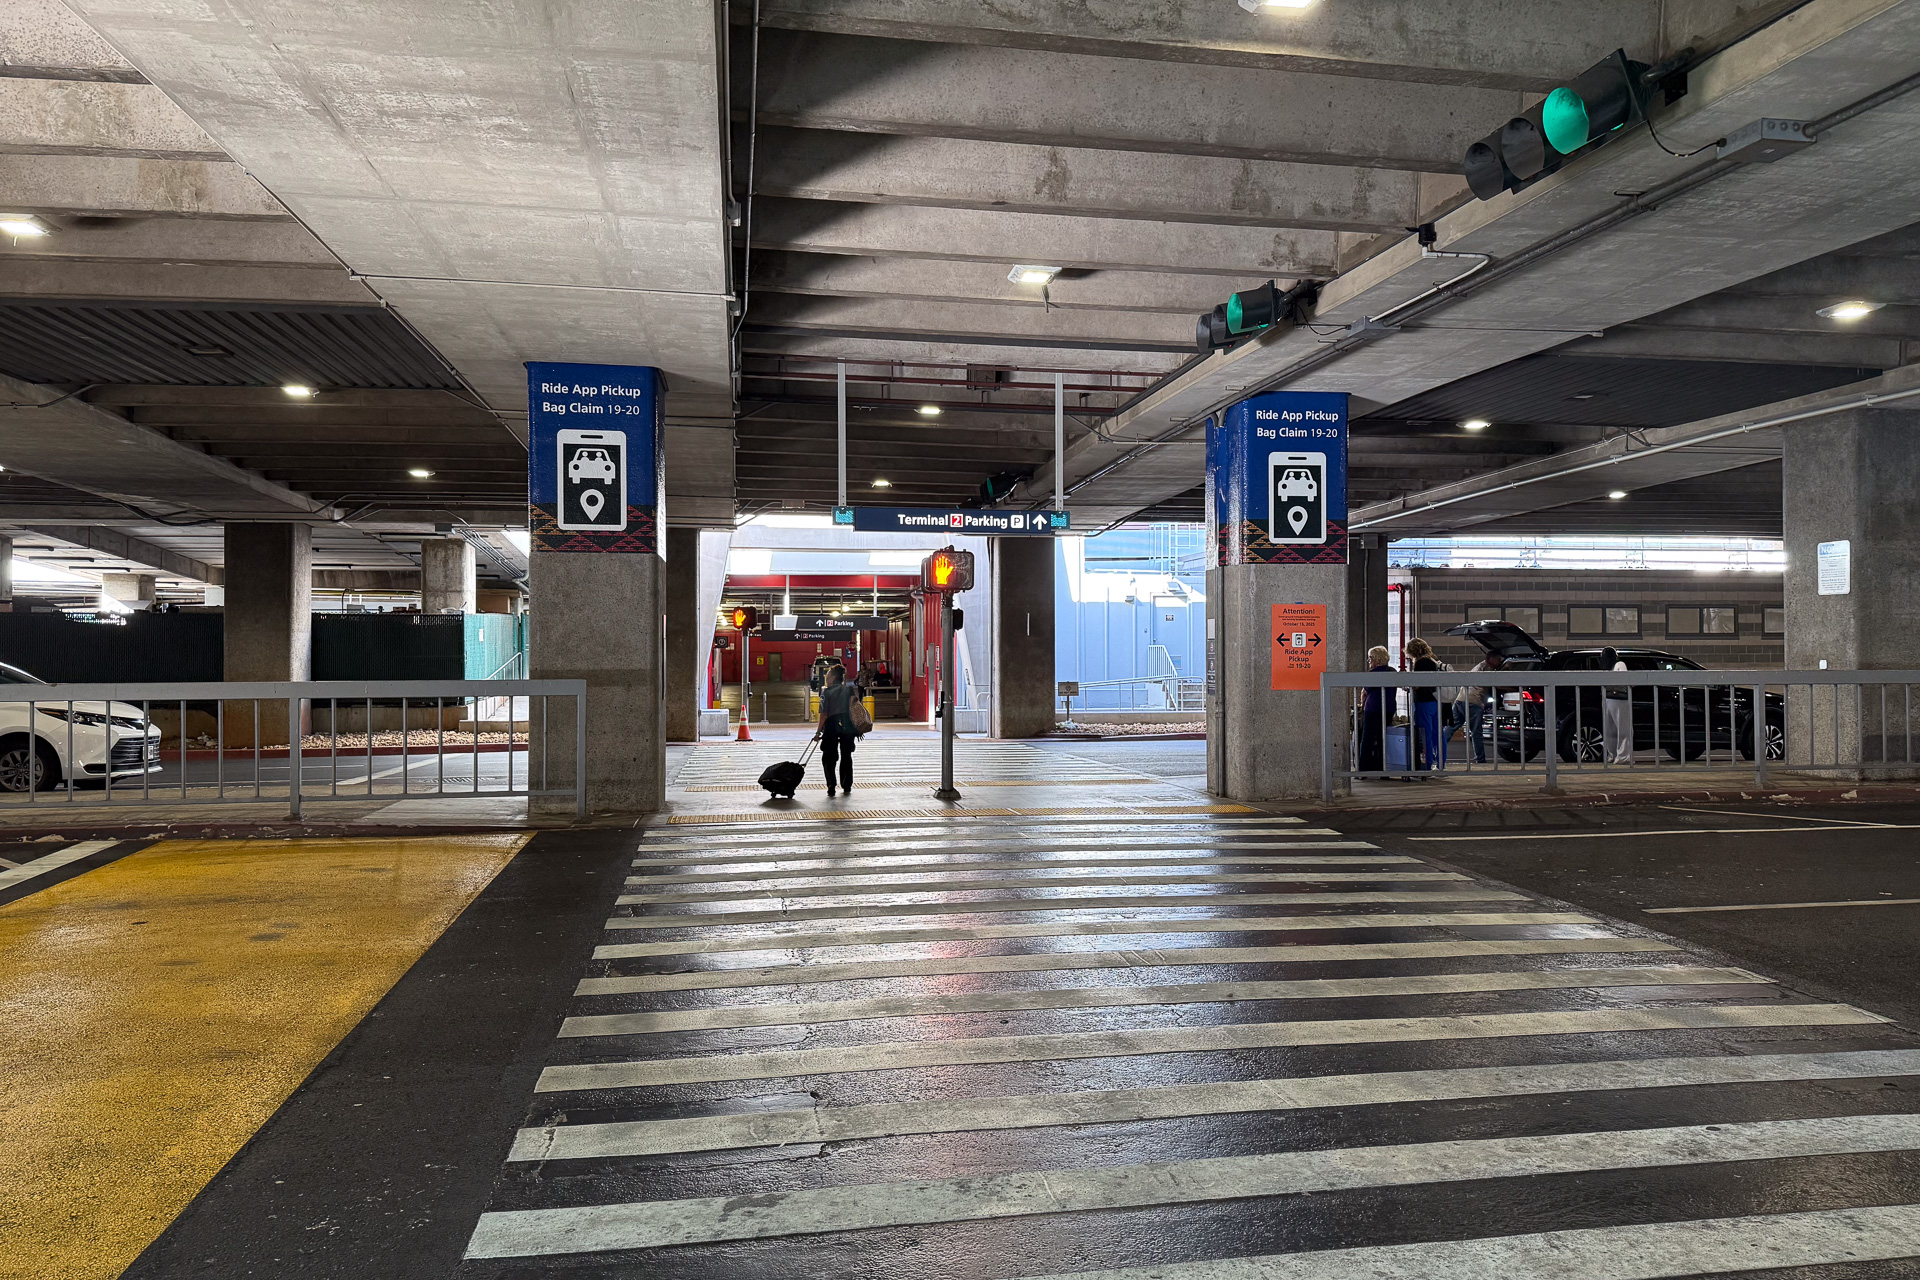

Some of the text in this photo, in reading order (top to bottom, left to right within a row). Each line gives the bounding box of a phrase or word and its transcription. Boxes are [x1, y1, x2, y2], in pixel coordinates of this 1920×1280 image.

[541, 382, 641, 399] Ride App Pickup
[542, 401, 640, 415] Bag Claim 19-20
[1256, 409, 1339, 422] Ride App Pickup
[1256, 427, 1338, 439] Bag Claim 19-20
[897, 513, 949, 527] Terminal
[965, 514, 1008, 529] Parking
